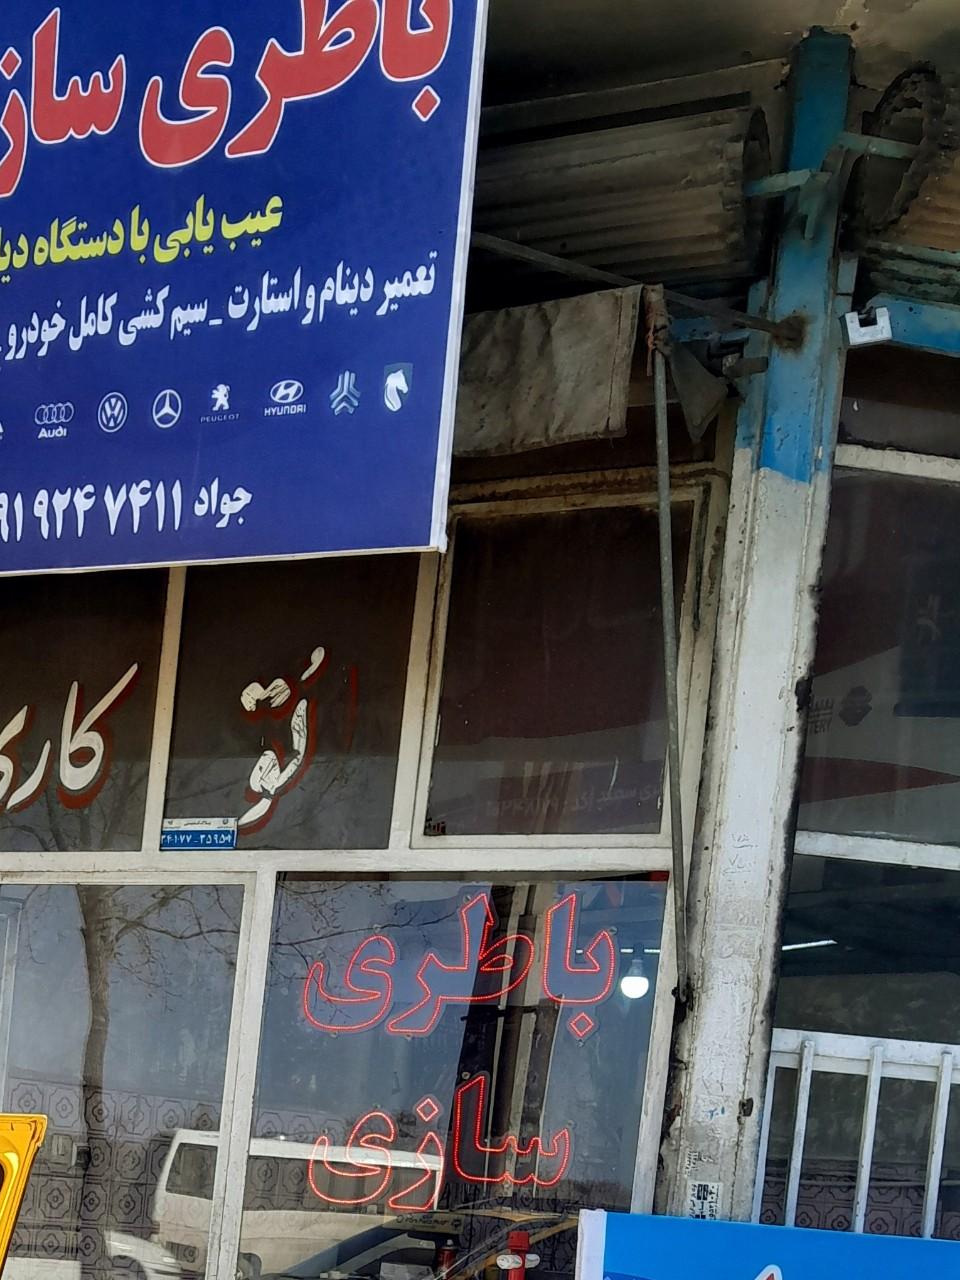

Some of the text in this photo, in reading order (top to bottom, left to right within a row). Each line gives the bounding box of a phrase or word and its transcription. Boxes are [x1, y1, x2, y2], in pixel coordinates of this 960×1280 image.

[33, 216, 125, 267] دستگاه
[129, 204, 150, 264] با
[153, 194, 215, 264] یابی
[221, 195, 284, 250] عیب
[228, 266, 301, 332] استارت
[301, 283, 316, 325] و
[319, 260, 375, 322] دینام
[375, 250, 438, 316] تعمیر
[4, 300, 67, 361] خودرو
[68, 291, 118, 352] کامل
[118, 285, 170, 346] کشی
[170, 298, 208, 341] سیم
[38, 427, 68, 439] Audi
[200, 413, 240, 423] PEUGEOT
[264, 404, 307, 416] HYUNDAI
[33, 484, 96, 540] ۹۲۴
[103, 479, 183, 536] ۷۴۱۱
[194, 476, 253, 529] جواد
[303, 892, 617, 1038] باطری
[308, 1076, 571, 1211] سازی
